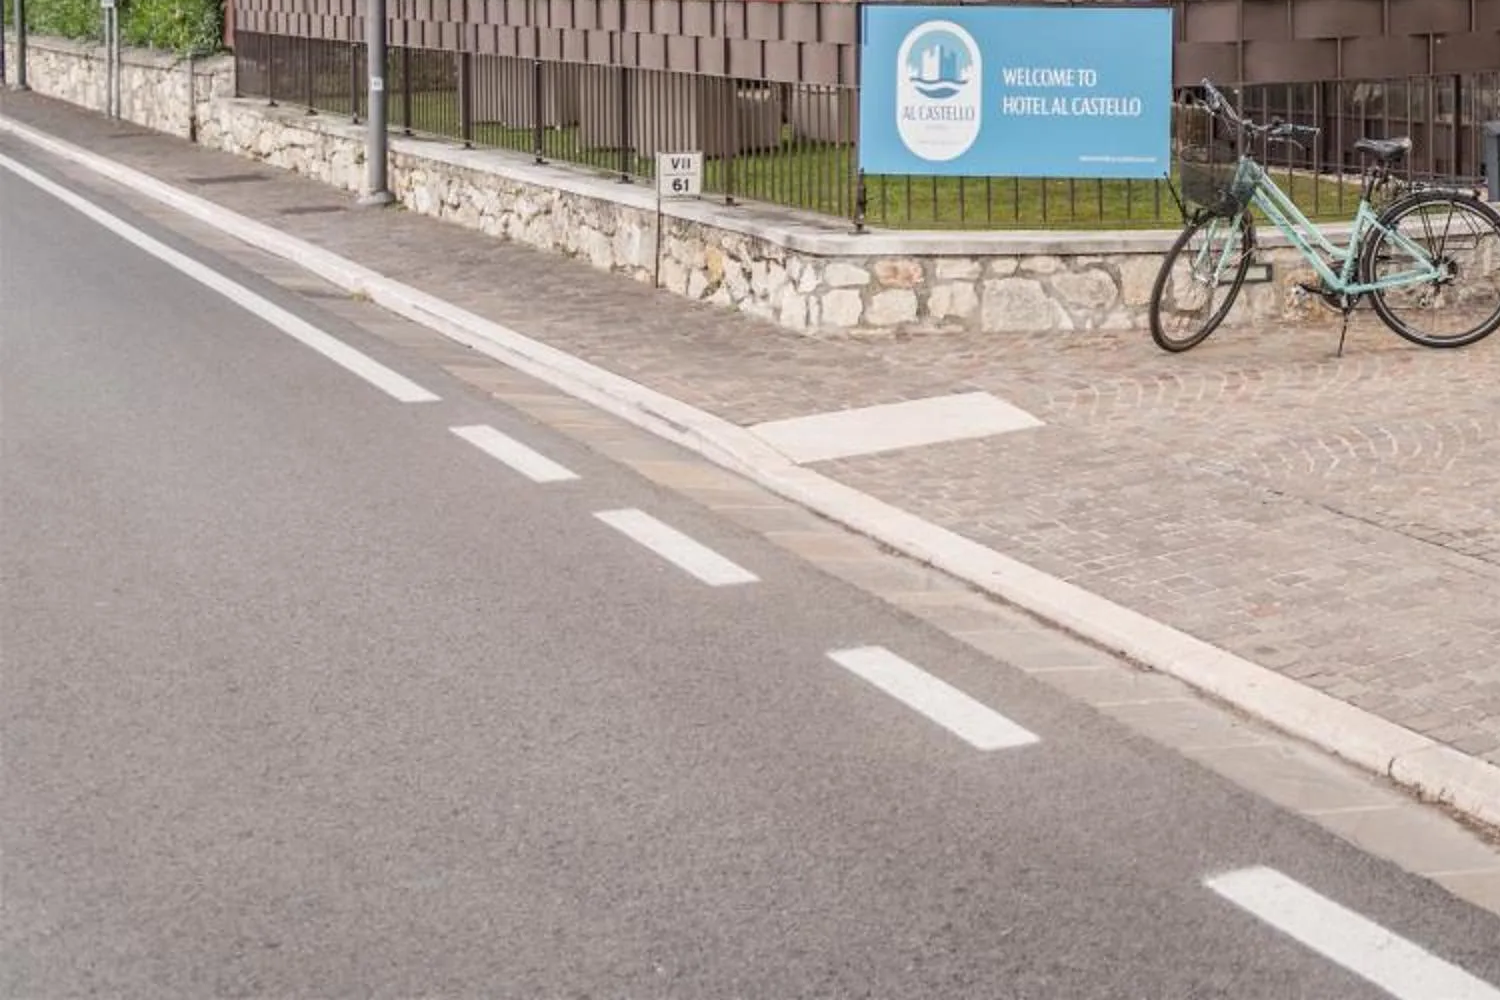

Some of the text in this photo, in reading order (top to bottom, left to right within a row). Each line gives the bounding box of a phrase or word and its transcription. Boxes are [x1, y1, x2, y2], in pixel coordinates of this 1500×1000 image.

[1003, 68, 1096, 87] WELCOME TO
[903, 105, 976, 121] AL CASTELLO
[1003, 96, 1142, 117] HOTEL AL CASTELLO
[672, 178, 689, 192] 61
